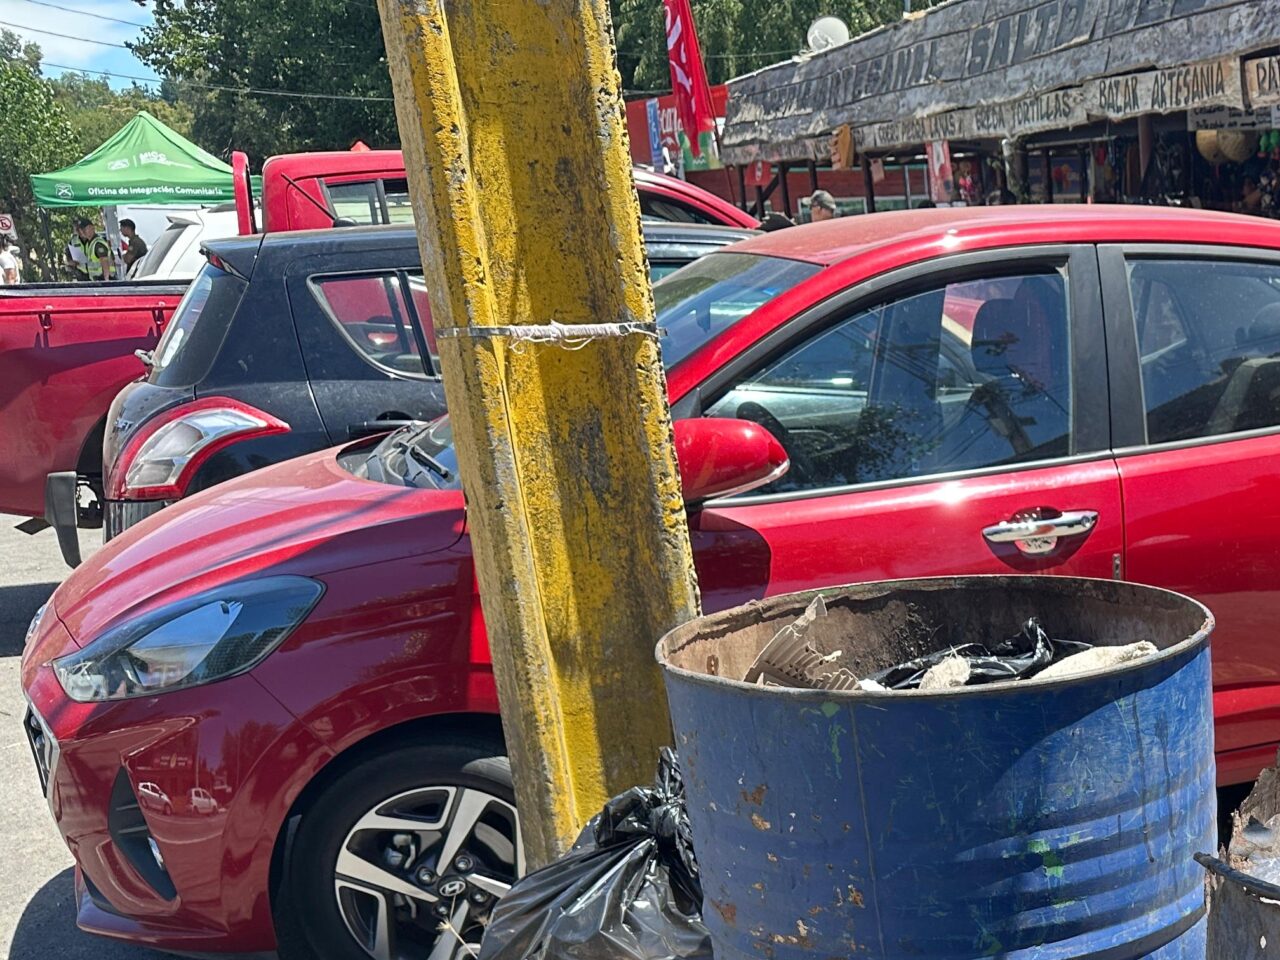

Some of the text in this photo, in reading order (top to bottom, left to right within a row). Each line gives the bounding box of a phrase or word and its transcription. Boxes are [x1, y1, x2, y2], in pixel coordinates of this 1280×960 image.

[1100, 61, 1225, 114] BAZAR ARTESANIA
[1012, 90, 1072, 129] TORTILLAS
[88, 187, 113, 195] Oficina
[130, 185, 174, 195] Integración
[175, 186, 223, 195] Comunitaria
